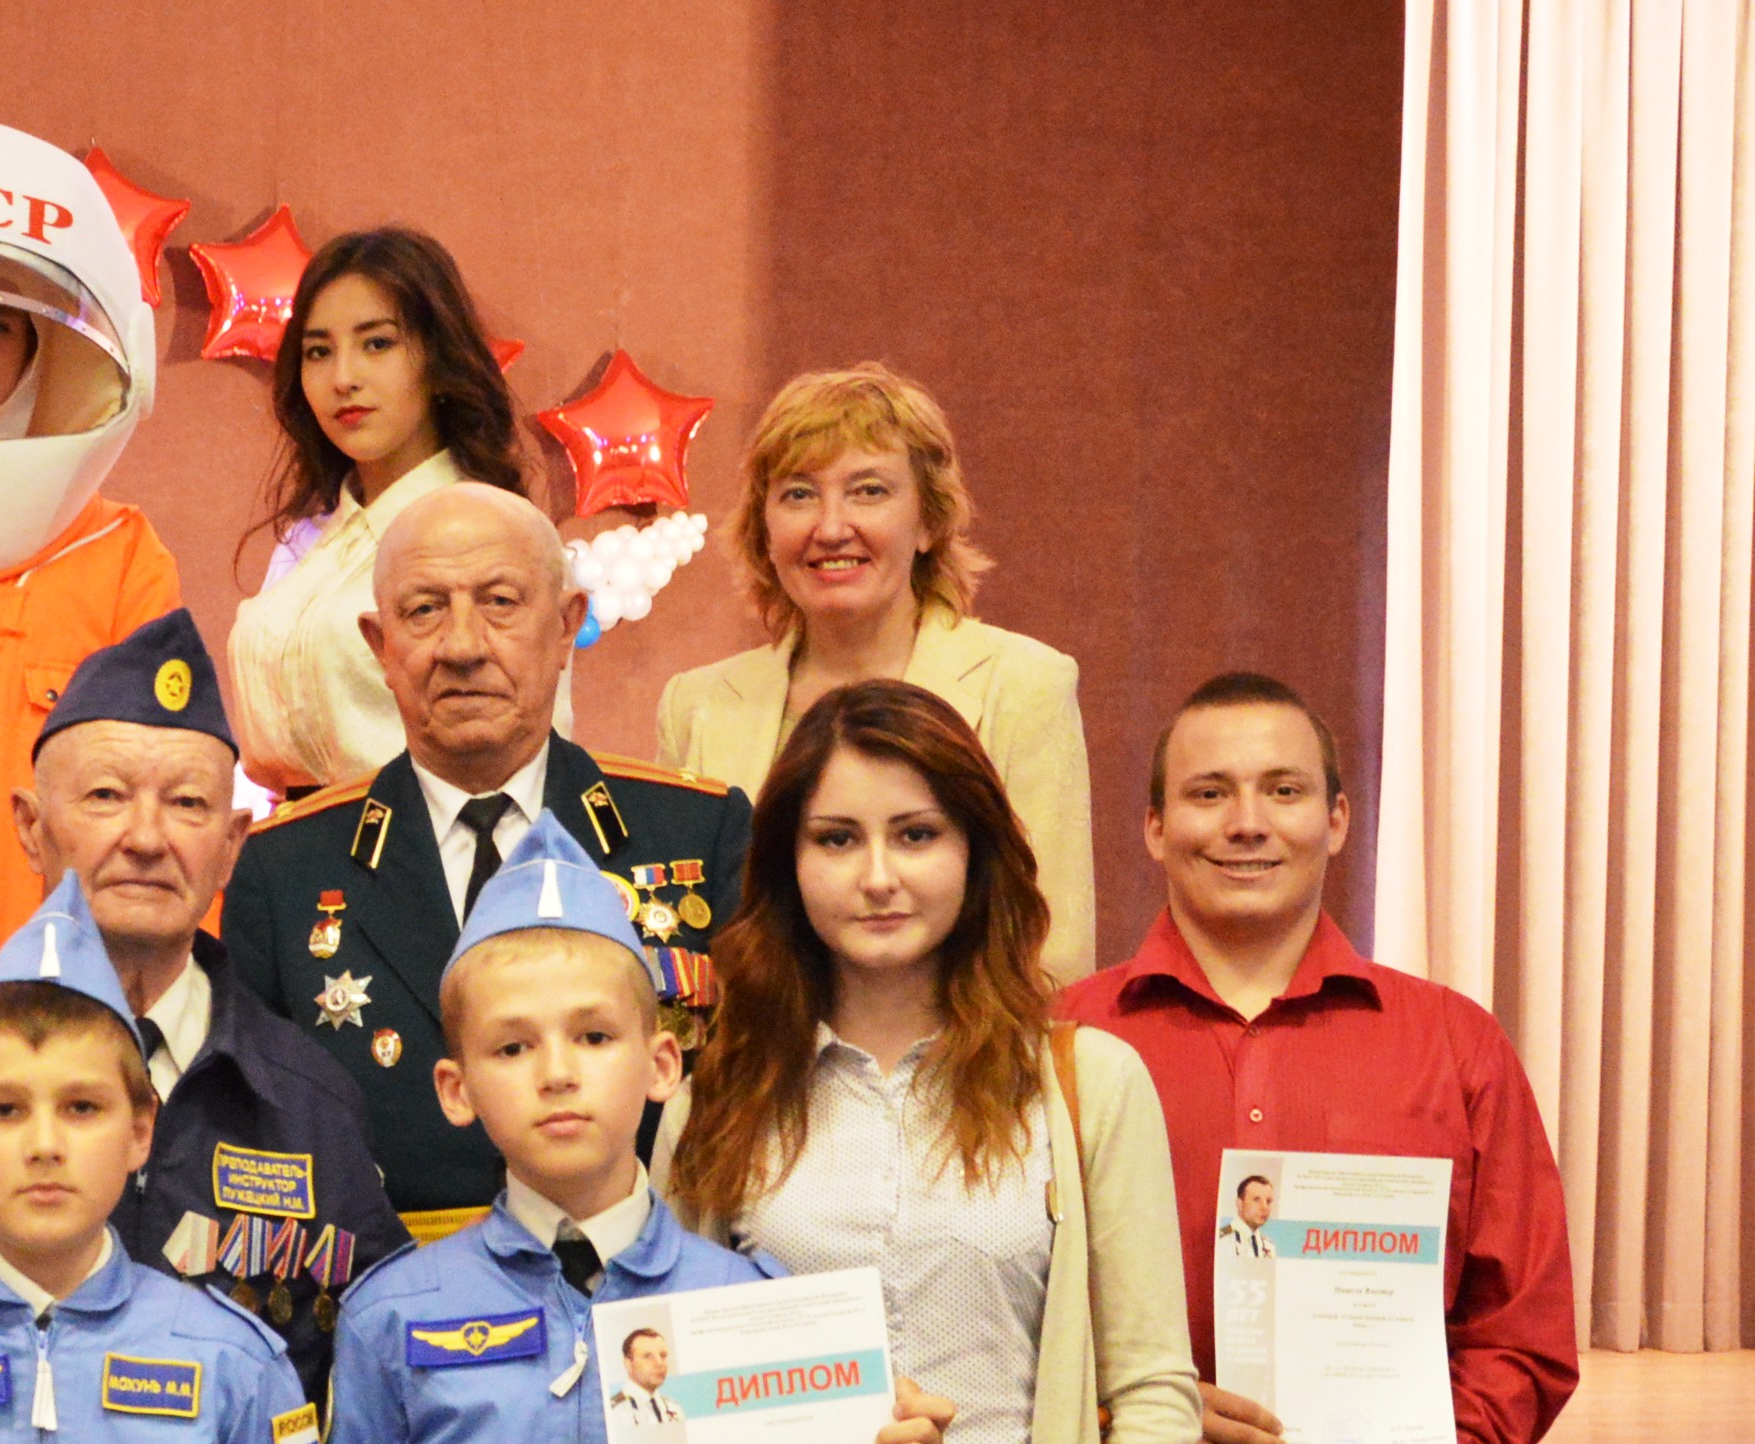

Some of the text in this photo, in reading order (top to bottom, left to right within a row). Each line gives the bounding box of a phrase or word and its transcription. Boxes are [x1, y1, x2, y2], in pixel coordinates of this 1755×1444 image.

[1301, 1228, 1420, 1256] ДИПЛОМ
[109, 1375, 162, 1394] МОХУНЬ
[715, 1359, 861, 1409] ДИПЛОМ
